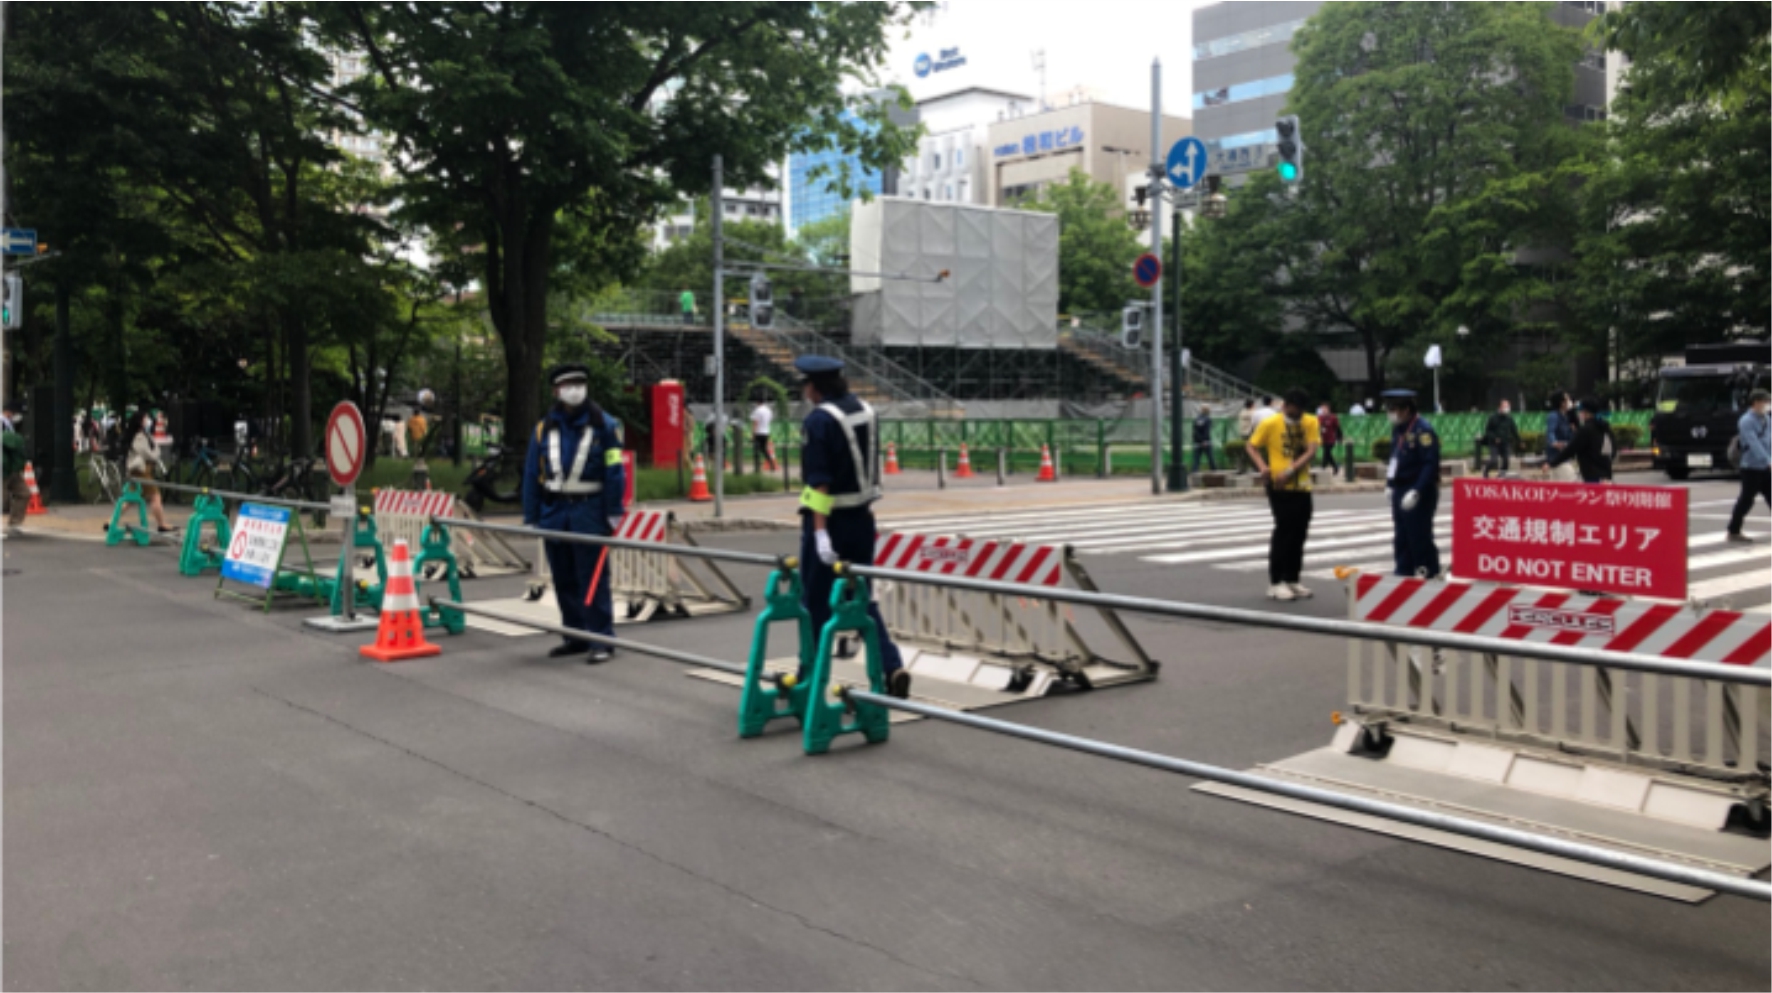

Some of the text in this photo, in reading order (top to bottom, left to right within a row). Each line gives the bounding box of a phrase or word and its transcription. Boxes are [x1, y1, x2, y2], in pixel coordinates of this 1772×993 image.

[1473, 515, 1660, 550] 交通規制エリア
[1478, 554, 1652, 587] DO NOT ENTER
